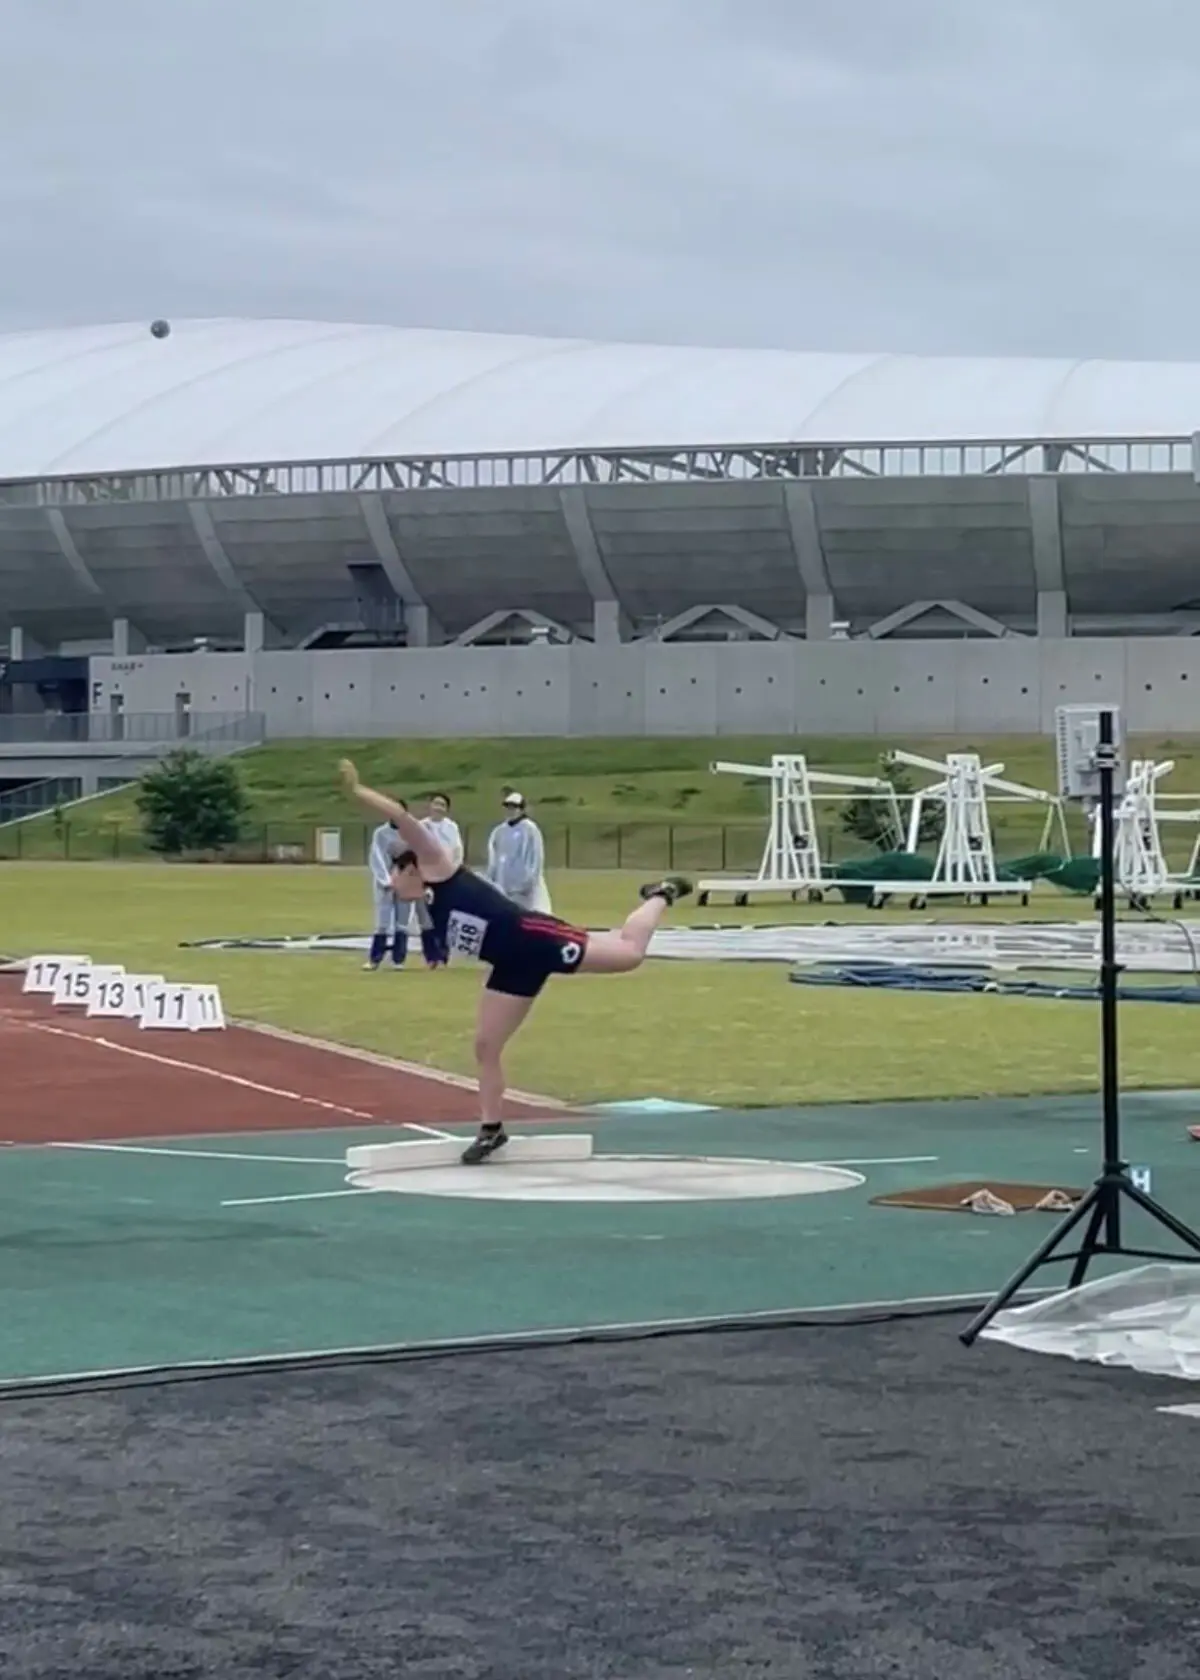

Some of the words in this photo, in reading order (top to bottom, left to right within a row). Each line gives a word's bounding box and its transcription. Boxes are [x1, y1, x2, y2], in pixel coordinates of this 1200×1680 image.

[34, 963, 60, 986] 17
[63, 973, 91, 997] 15
[97, 982, 125, 1008] 13
[134, 981, 158, 1008] 1
[154, 993, 184, 1020] 11
[198, 993, 217, 1020] 11
